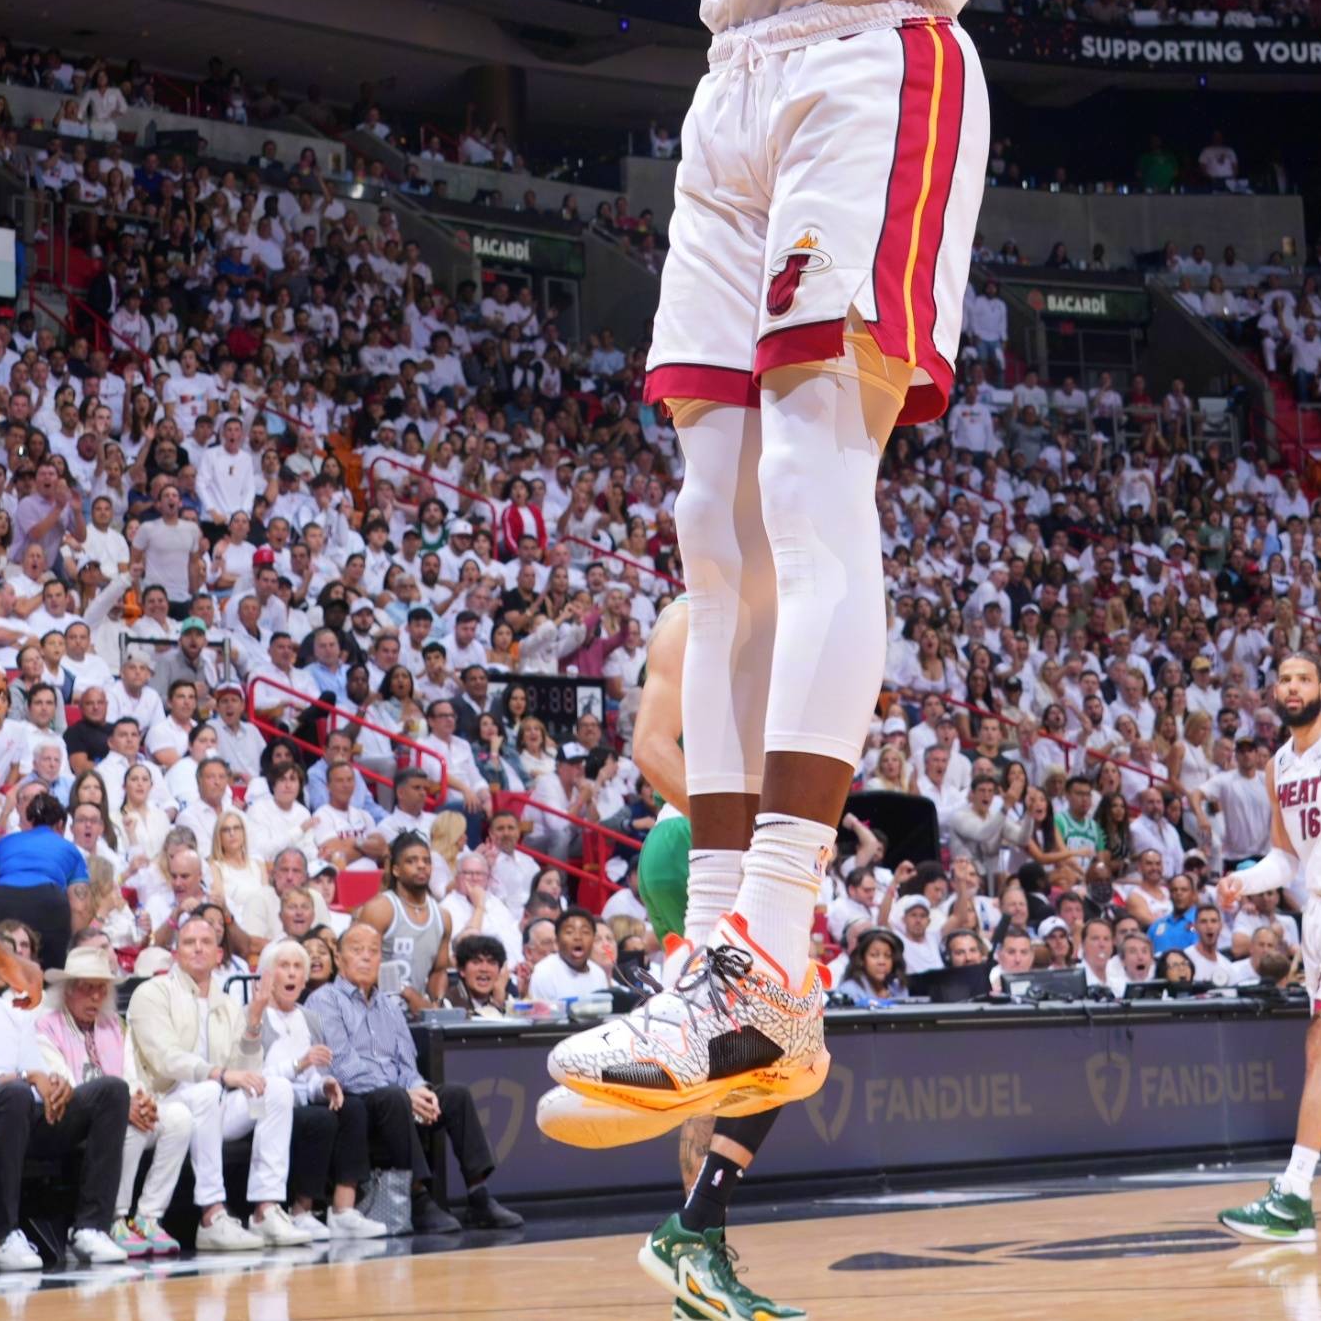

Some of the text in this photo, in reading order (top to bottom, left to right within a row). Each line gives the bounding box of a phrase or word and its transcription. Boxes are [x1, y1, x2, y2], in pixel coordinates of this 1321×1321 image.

[1081, 36, 1243, 64] SUPPORTING
[473, 236, 530, 261] BACARDÍ
[1047, 293, 1106, 315] BACARDÍ
[1300, 807, 1321, 841] 16
[1141, 1052, 1284, 1107] FANDUEL
[865, 1073, 1032, 1123] FANDUEL
